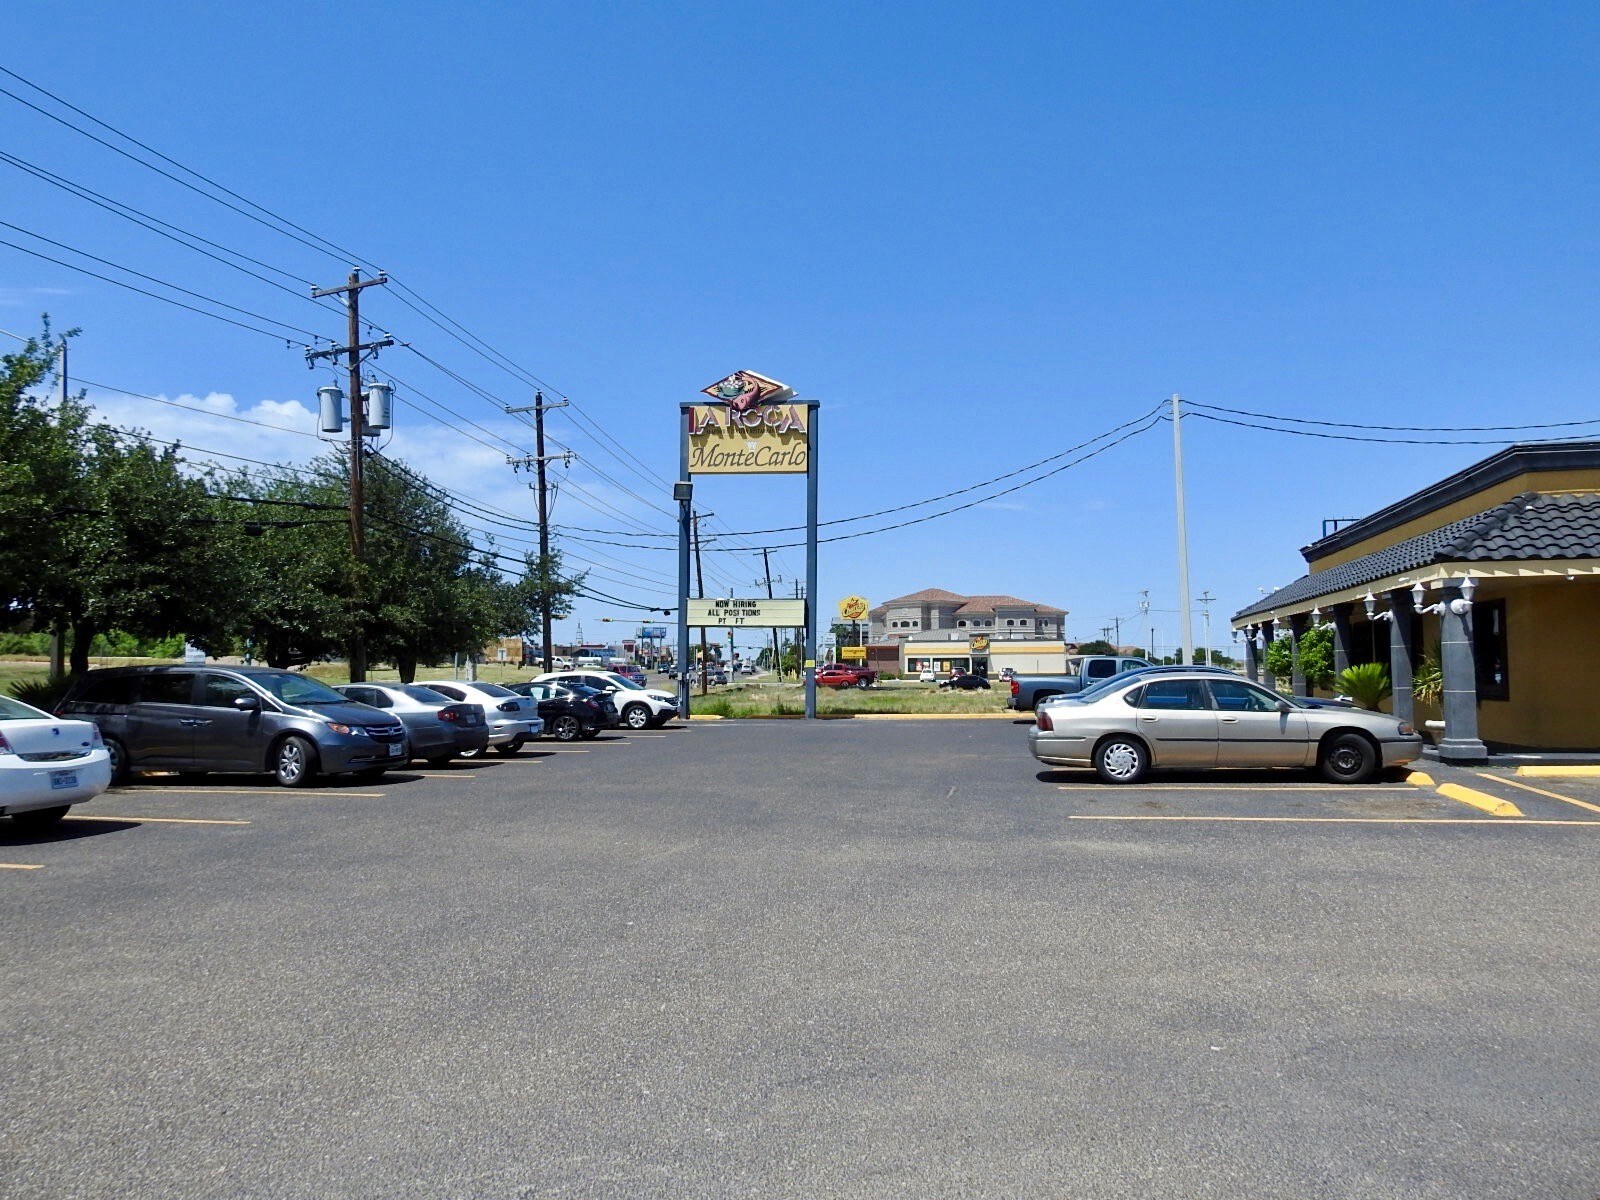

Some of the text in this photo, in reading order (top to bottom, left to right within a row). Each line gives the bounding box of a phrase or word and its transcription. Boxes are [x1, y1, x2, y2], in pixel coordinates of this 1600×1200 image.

[725, 404, 806, 433] ROCA
[715, 600, 757, 608] NOW HIRING
